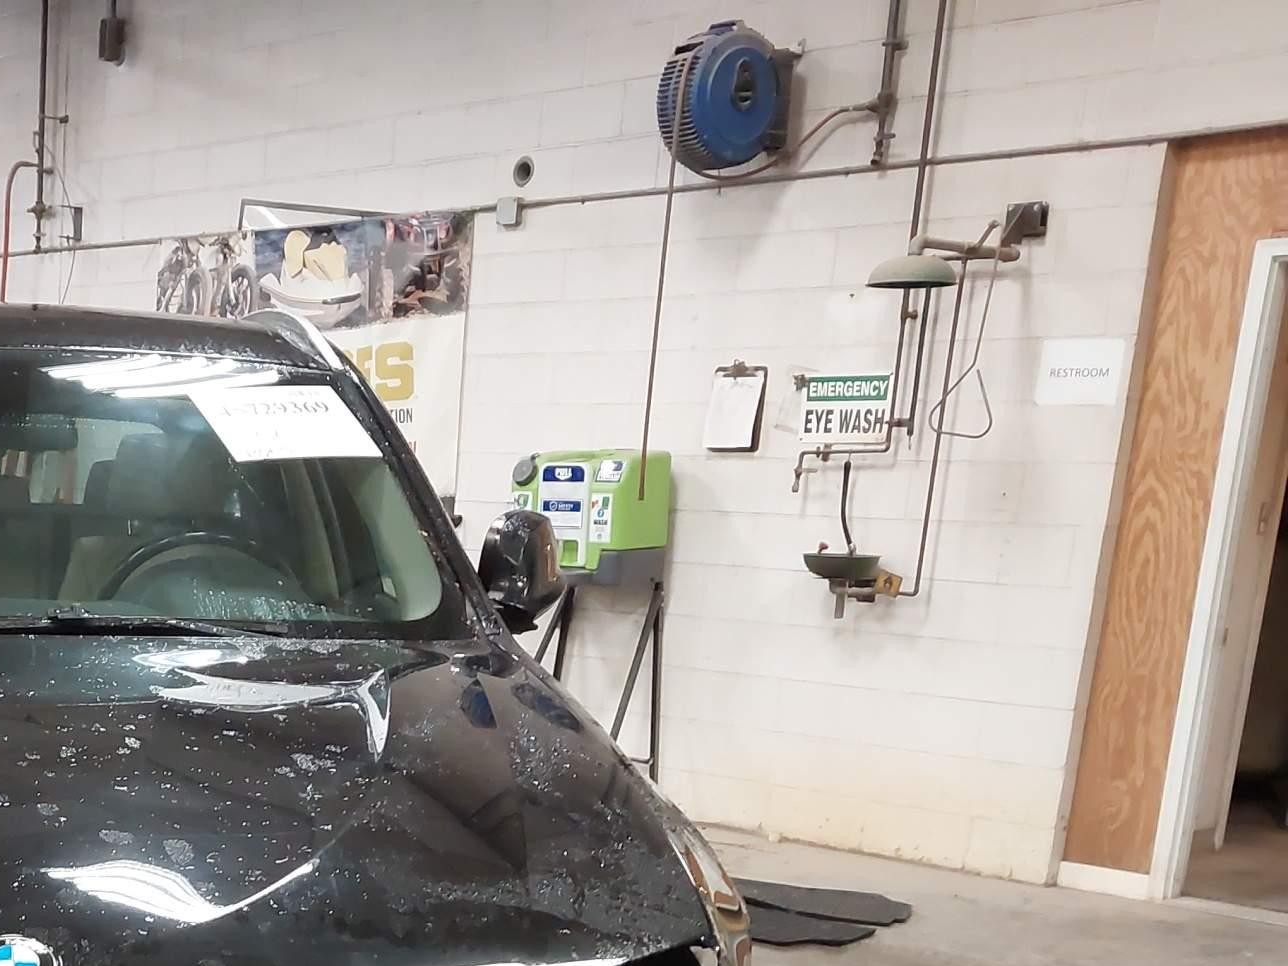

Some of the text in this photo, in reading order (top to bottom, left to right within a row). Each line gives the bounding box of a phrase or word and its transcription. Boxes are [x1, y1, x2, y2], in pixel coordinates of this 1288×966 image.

[1049, 367, 1110, 378] RESTROOM
[809, 380, 888, 398] EMERGENCY
[803, 408, 886, 434] EYE WASH
